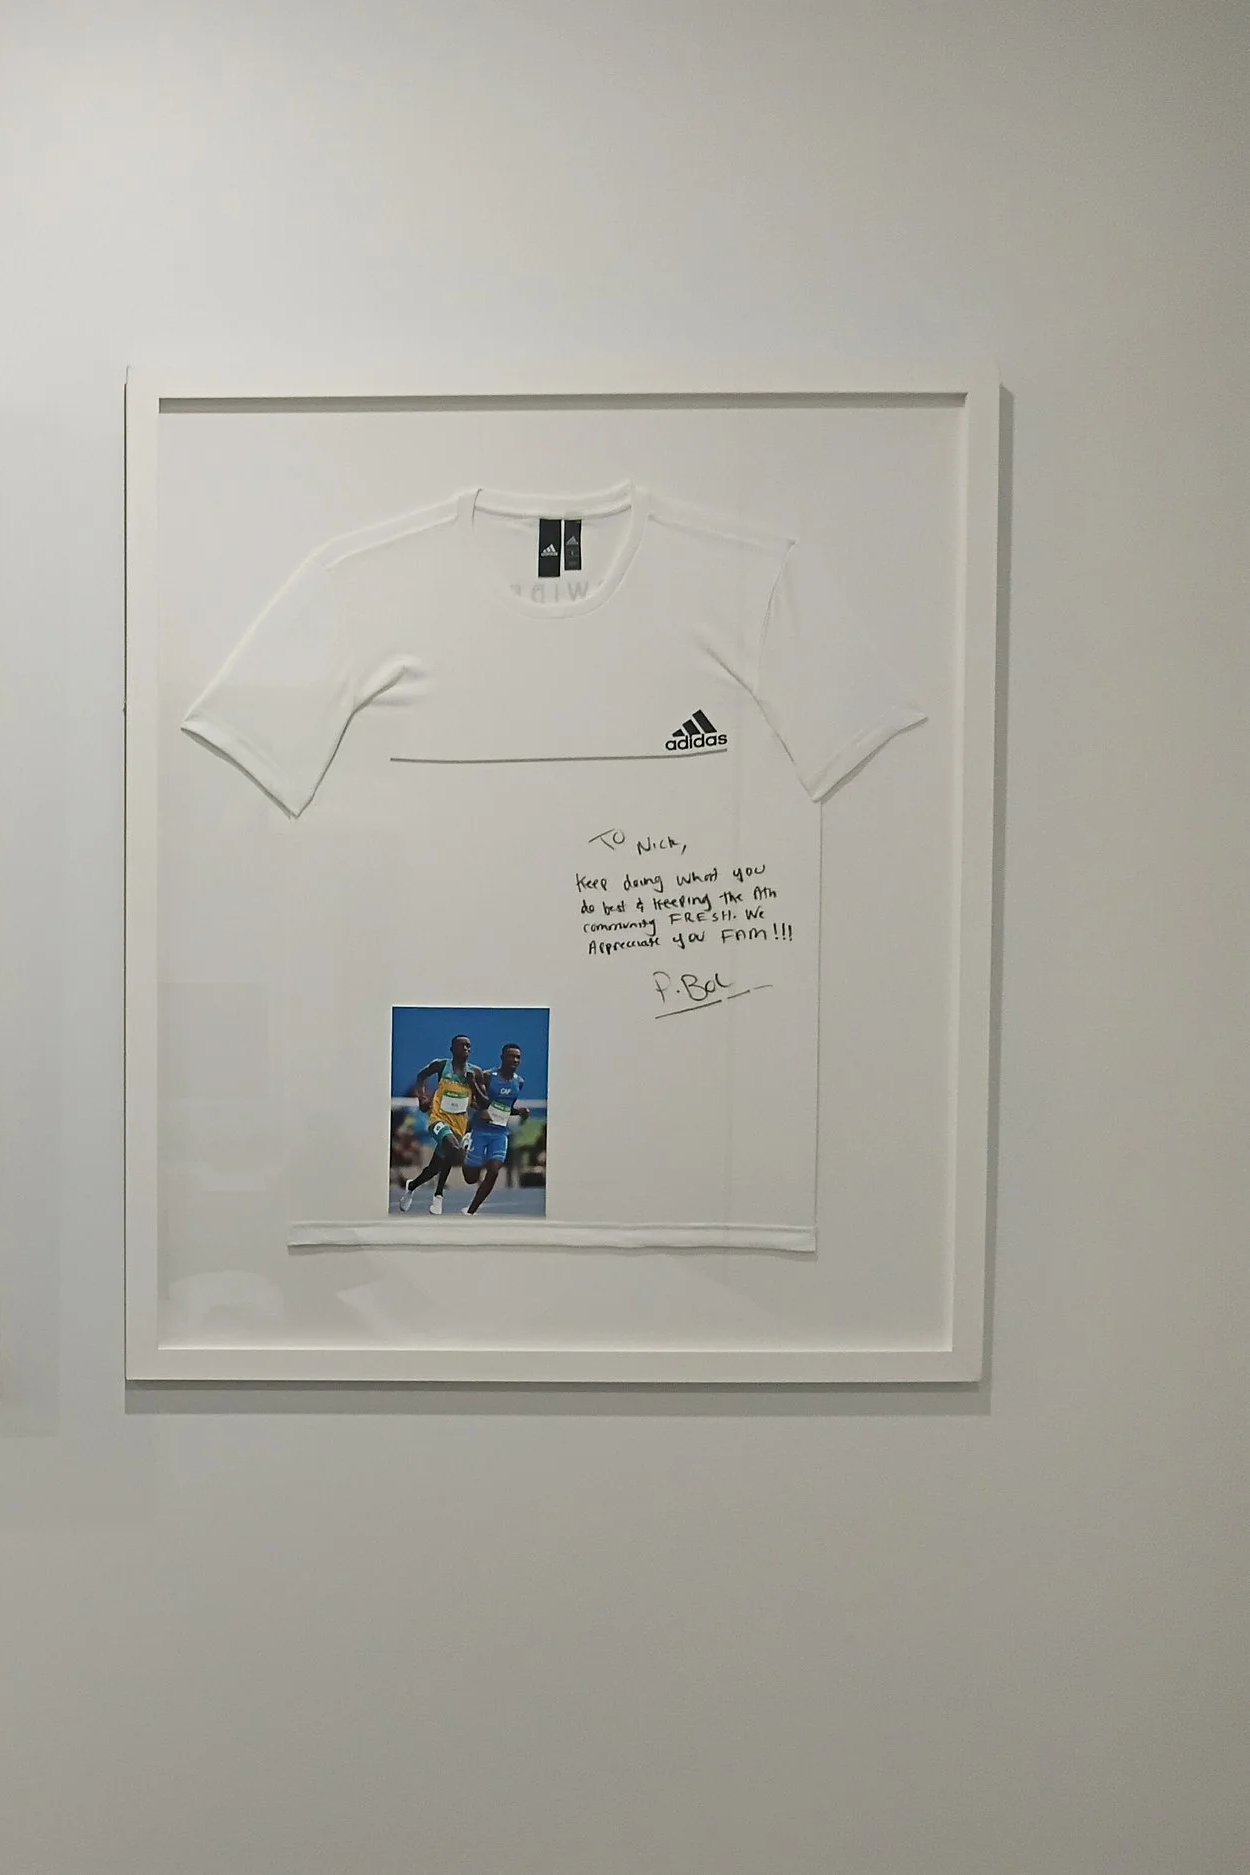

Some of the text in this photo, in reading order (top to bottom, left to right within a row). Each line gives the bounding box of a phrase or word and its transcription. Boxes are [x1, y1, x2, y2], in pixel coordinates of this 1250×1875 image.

[665, 733, 728, 751] adidas
[623, 873, 664, 893] doing
[732, 864, 766, 883] you
[580, 899, 595, 914] do
[602, 899, 626, 915] best
[583, 918, 657, 937] community
[745, 905, 765, 920] We
[672, 932, 705, 949] you
